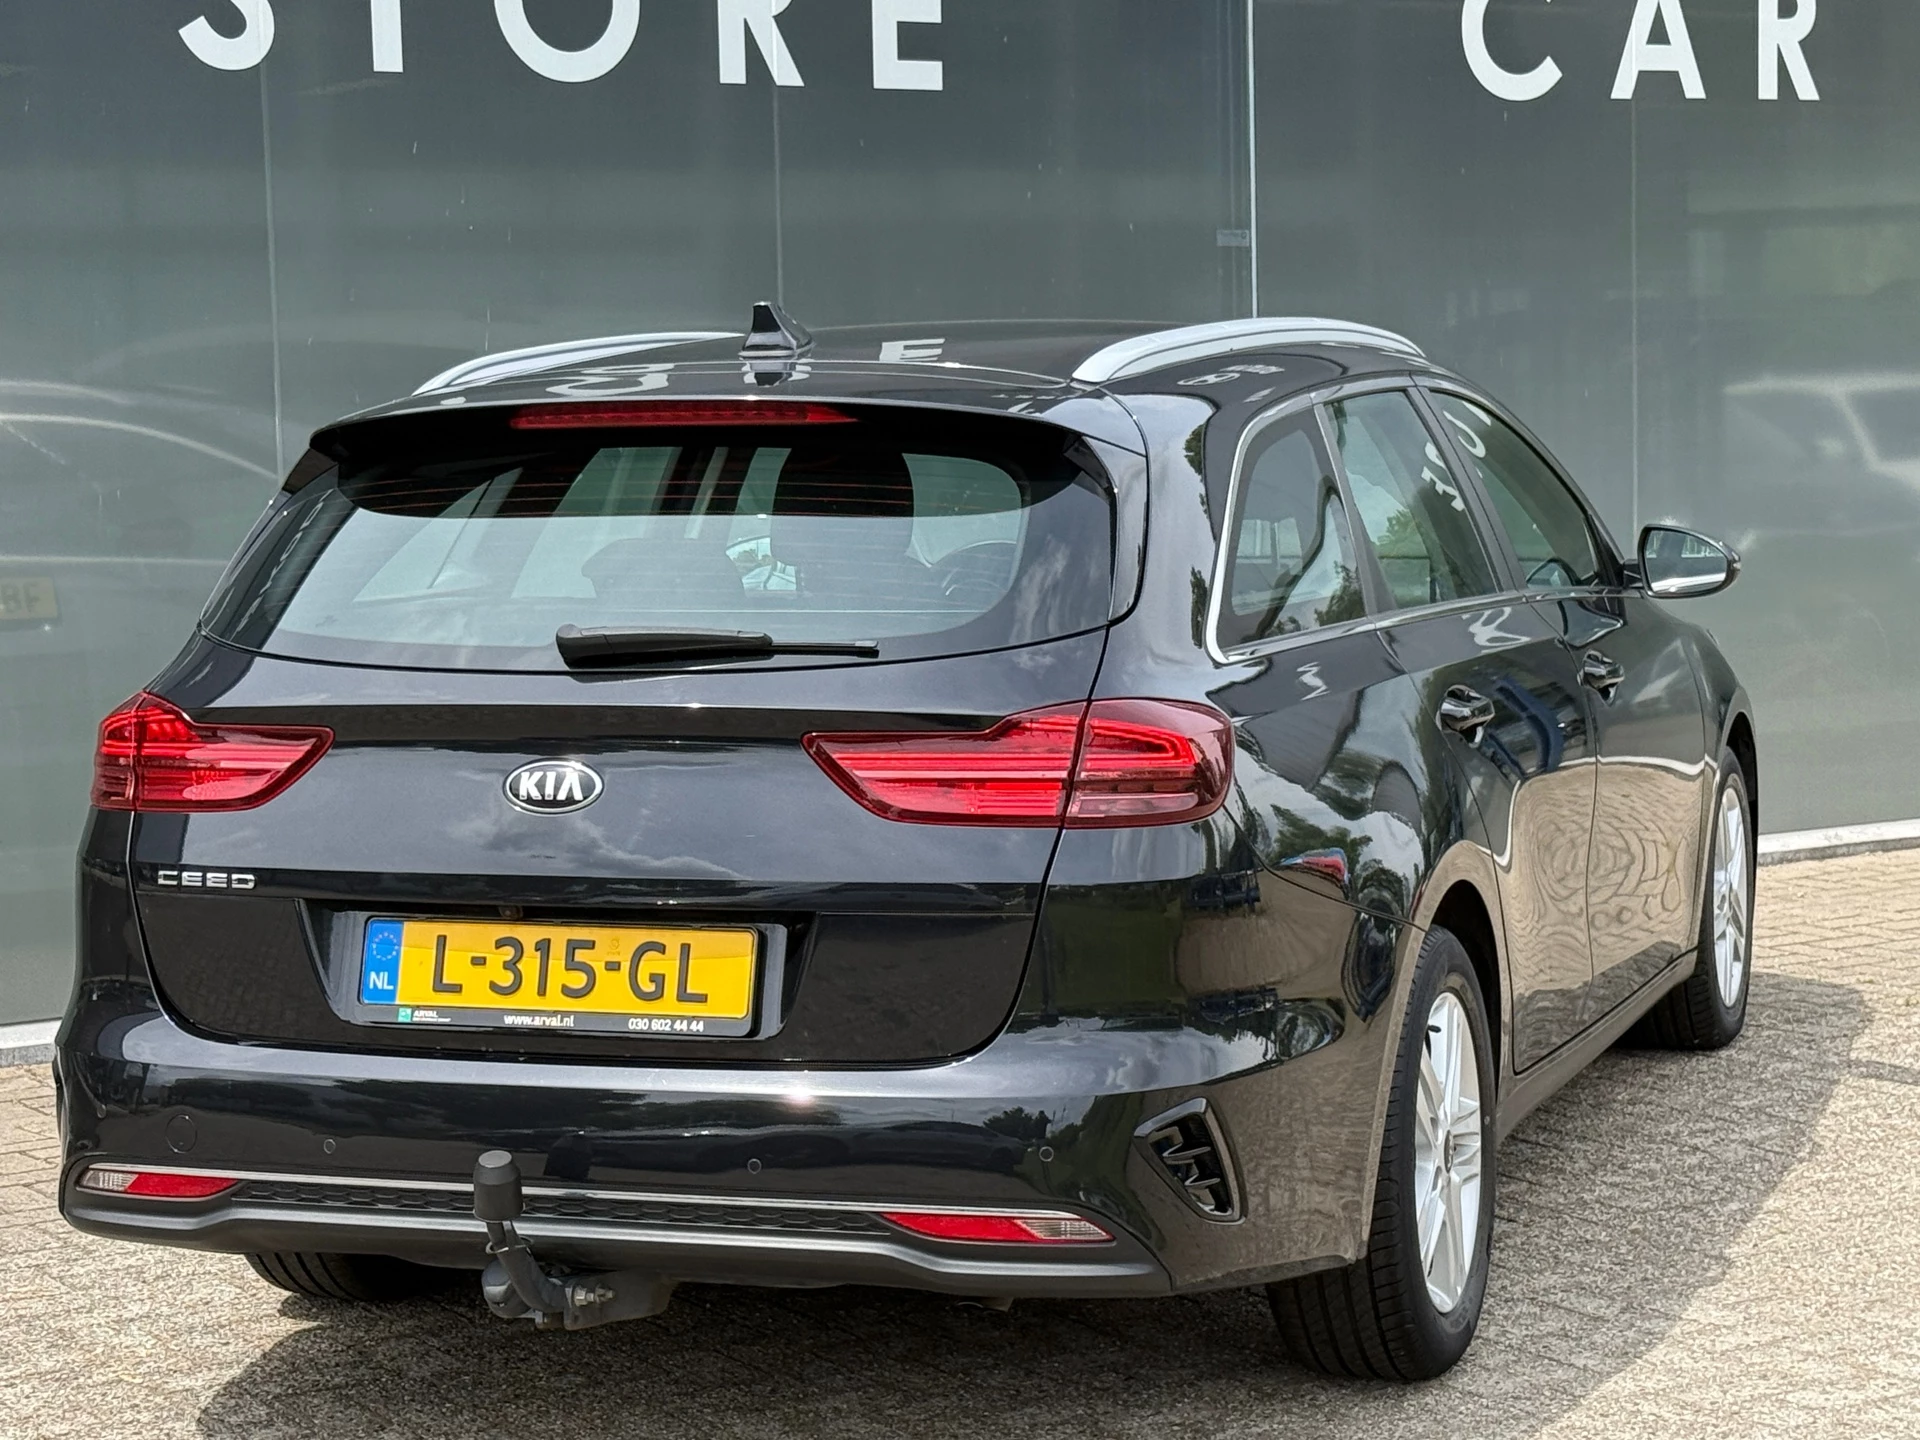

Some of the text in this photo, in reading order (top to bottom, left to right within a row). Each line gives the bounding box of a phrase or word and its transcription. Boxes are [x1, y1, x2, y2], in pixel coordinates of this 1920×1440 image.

[1461, 0, 1820, 101] CAR
[519, 771, 584, 801] KIA
[157, 870, 256, 890] CEED
[431, 934, 708, 1004] L-315-GL
[369, 971, 394, 991] NL
[503, 1014, 575, 1029] www.arval.nl
[628, 1017, 704, 1033] 030 602 44 44
